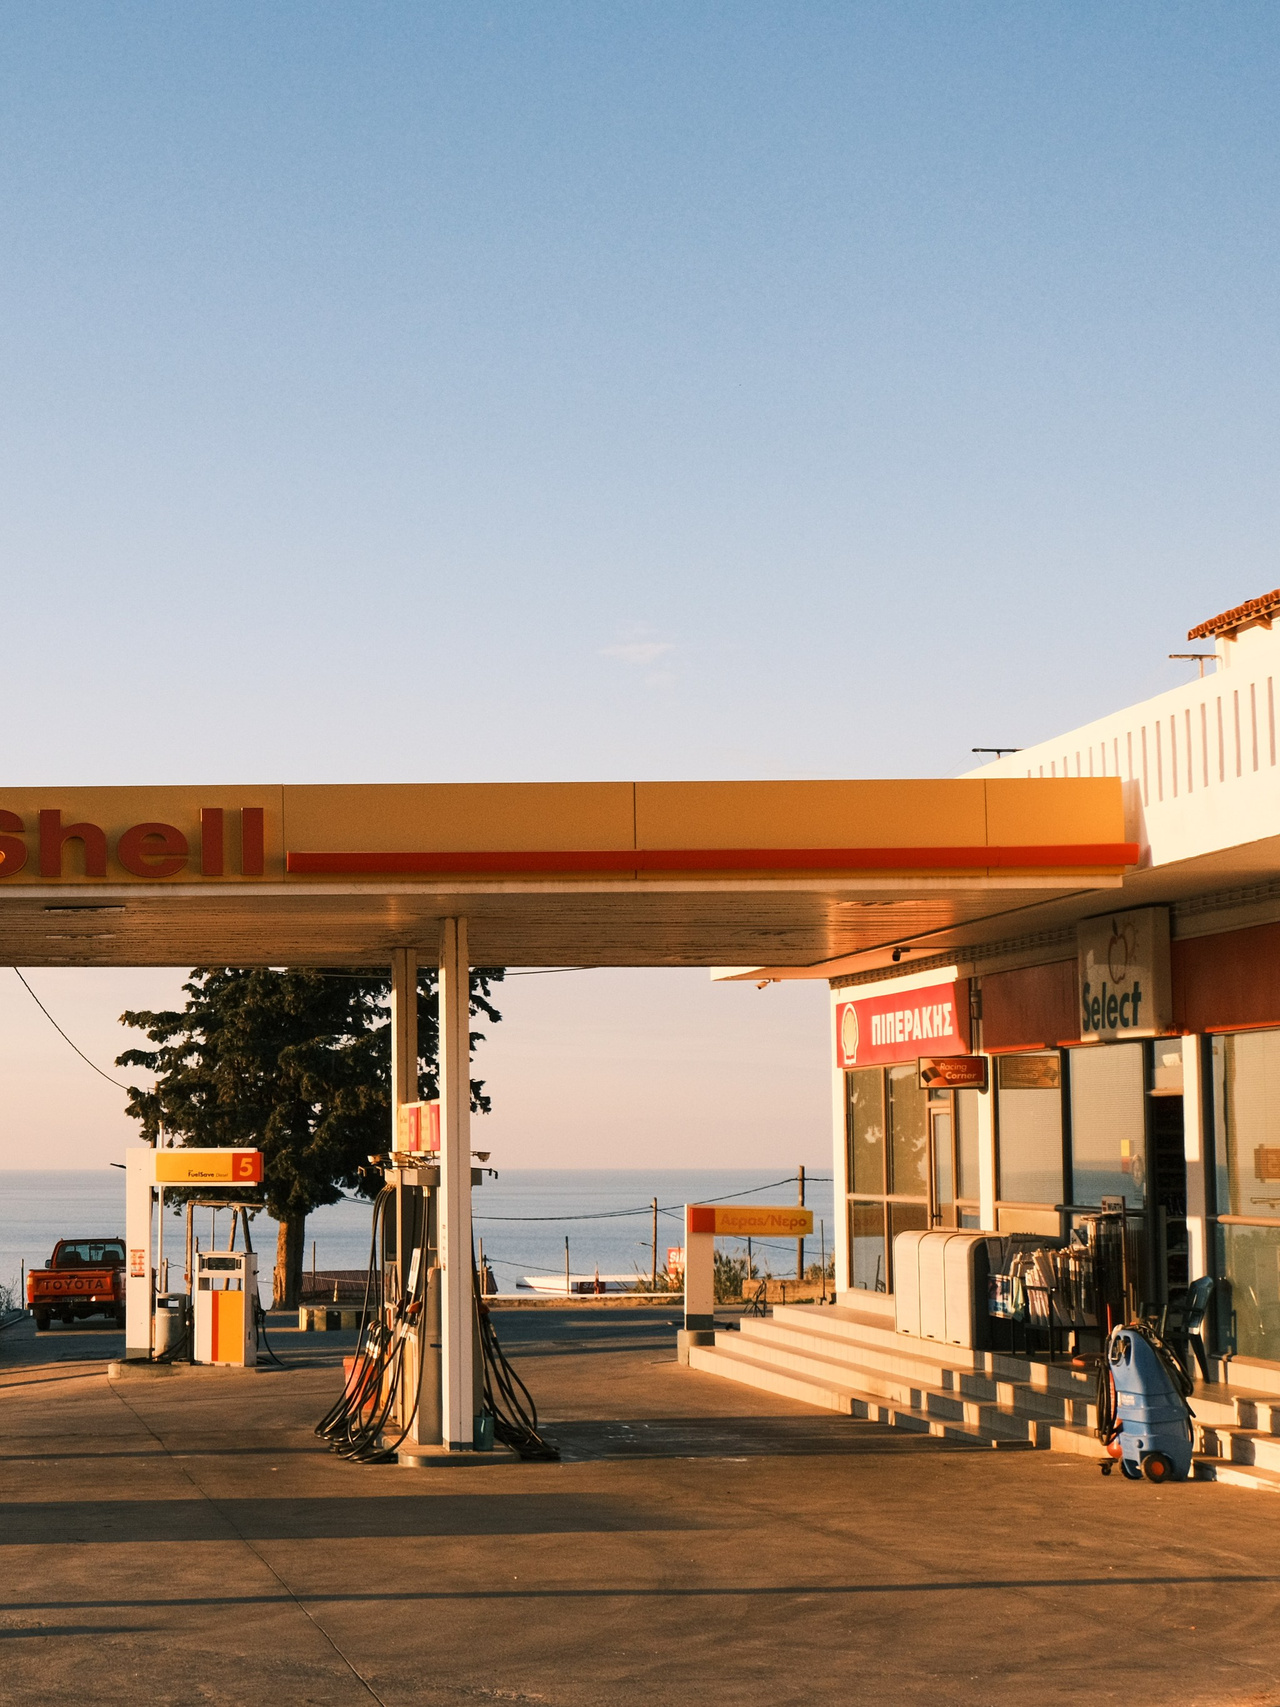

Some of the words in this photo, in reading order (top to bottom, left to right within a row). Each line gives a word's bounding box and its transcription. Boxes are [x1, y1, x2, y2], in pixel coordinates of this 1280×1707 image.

[1083, 981, 1142, 1032] Select
[871, 1002, 954, 1046] ΠΙΠΕΡΑΚΗΣ
[940, 1063, 968, 1072] Racing
[945, 1071, 977, 1080] Corner
[239, 1158, 253, 1177] 5
[44, 1279, 104, 1290] TOYOTA
